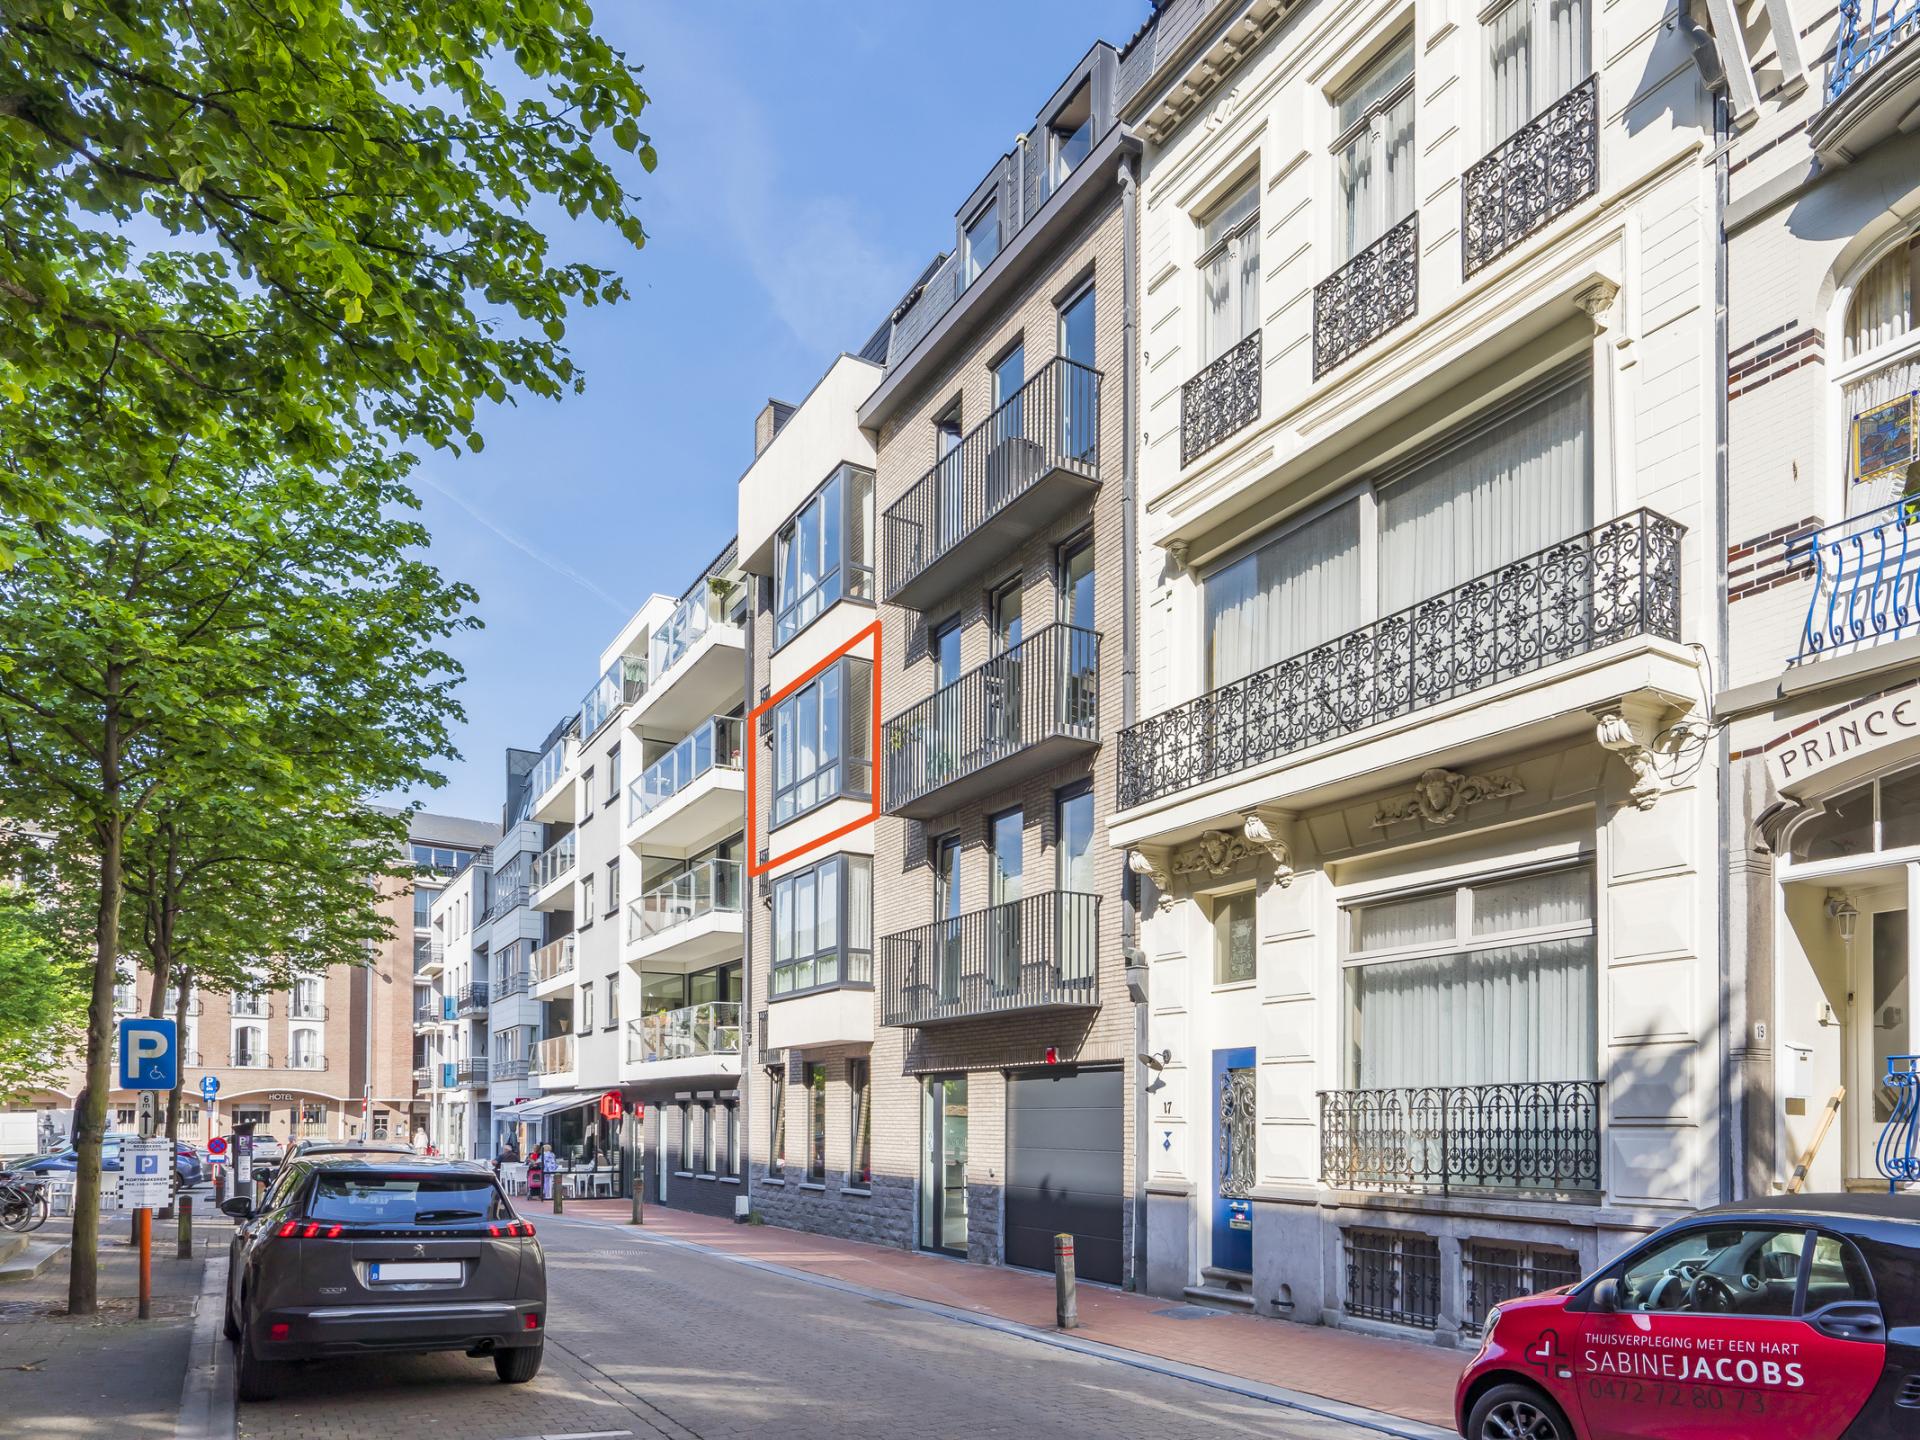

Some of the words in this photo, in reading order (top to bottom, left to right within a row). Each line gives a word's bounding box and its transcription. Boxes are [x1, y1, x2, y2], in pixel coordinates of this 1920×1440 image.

[1779, 699, 1917, 779] PRINCE
[127, 1030, 169, 1079] P
[268, 1093, 294, 1101] HOTEL
[1163, 1101, 1173, 1114] 17
[141, 1157, 153, 1173] P
[1584, 1333, 1692, 1349] THUISVERPLEGING
[1696, 1339, 1725, 1350] MET
[1729, 1340, 1755, 1352] EEN
[1760, 1342, 1800, 1355] HART
[1588, 1377, 1643, 1403] 0472
[1651, 1383, 1683, 1406] 72
[1692, 1386, 1723, 1409] 80
[1732, 1388, 1765, 1413] 73
